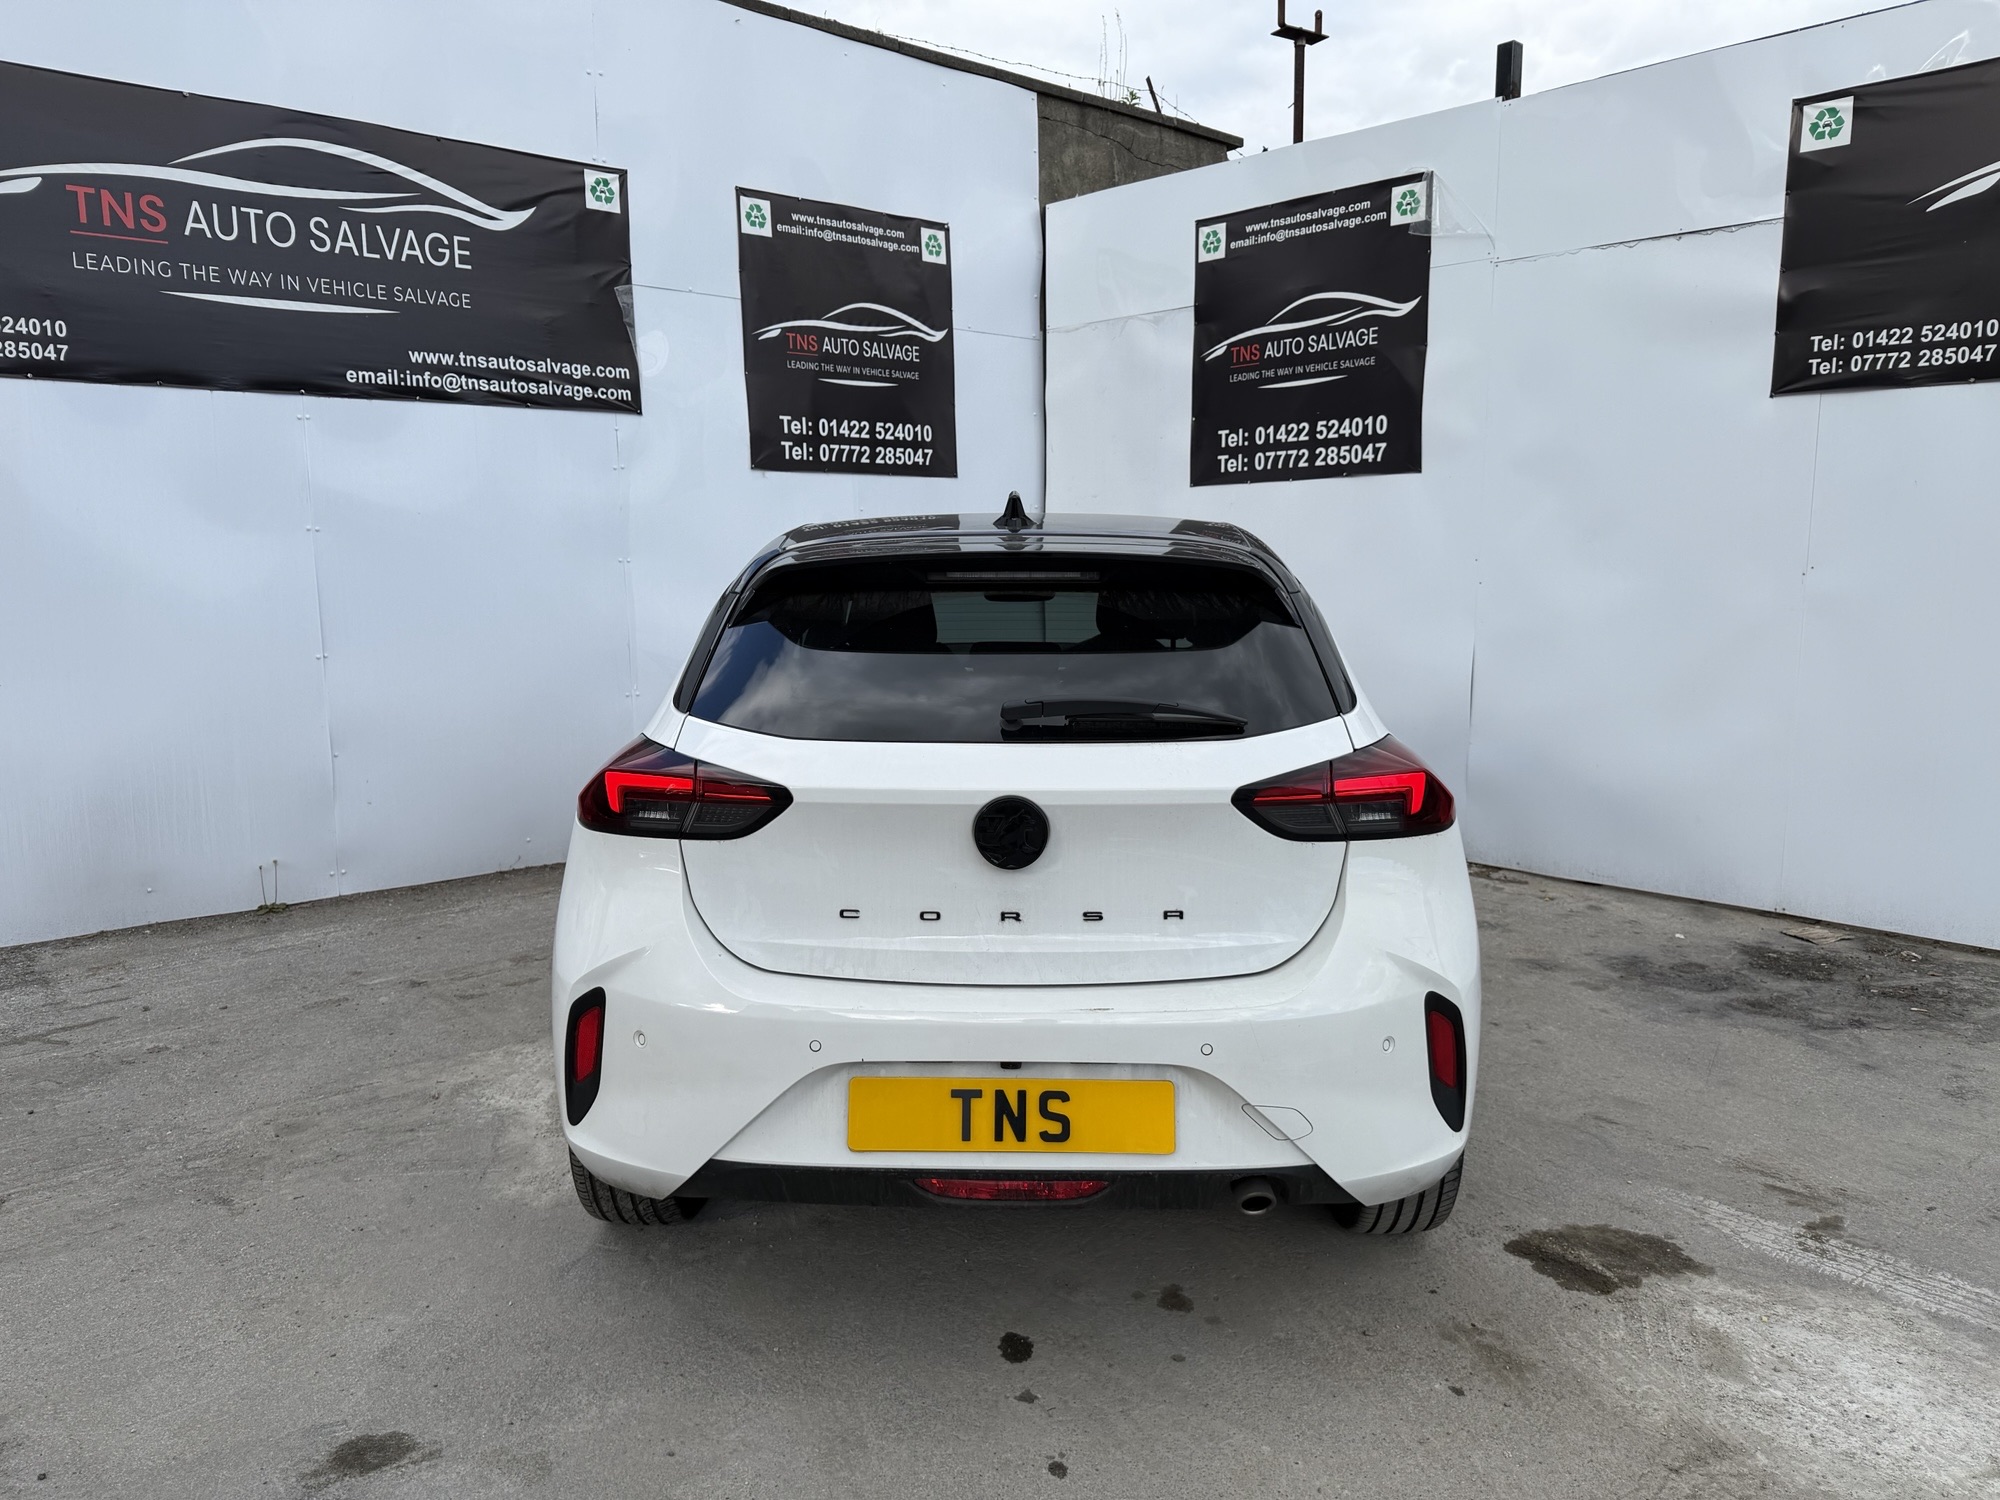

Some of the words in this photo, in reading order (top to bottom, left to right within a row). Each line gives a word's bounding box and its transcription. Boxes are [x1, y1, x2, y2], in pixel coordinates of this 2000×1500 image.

[65, 184, 168, 233] TNS
[184, 200, 296, 248] AUTO
[309, 216, 472, 270] SALVAGE
[791, 213, 905, 239] www.tnsautosalvage.com
[1229, 210, 1387, 250] email:info@tnsautosalvage.com
[1245, 200, 1371, 234] www.tnsautosalvage.com
[776, 222, 920, 254] email:info@tnsautosalvage.com
[71, 251, 172, 279] LEADING
[178, 262, 221, 284] THE
[227, 268, 274, 290] WAY
[280, 274, 300, 292] IN
[306, 276, 387, 300] VEHICLE
[393, 287, 472, 309] SALVAGE
[0, 315, 67, 337] 24010
[1810, 334, 1845, 352] Tel:
[1852, 326, 1913, 349] 01422
[1920, 318, 1999, 343] 524010
[0, 340, 69, 361] 85047
[786, 332, 818, 352] TNS
[822, 336, 860, 357] AUTO
[862, 341, 920, 362] SALVAGE
[1230, 343, 1260, 364] TNS
[1264, 337, 1305, 359] AUTO
[1308, 326, 1379, 353] SALVAGE
[1808, 357, 1843, 376] Tel:
[1850, 350, 1911, 372] 07772
[1917, 344, 1997, 367] 285047
[408, 350, 631, 380] www.tnsautosalvage.com
[786, 359, 819, 371] LEADING
[820, 363, 835, 373] THE
[835, 364, 851, 374] WAY
[852, 366, 861, 375] IN
[861, 367, 890, 378] VEHICLE
[891, 369, 920, 380] SALVAGE
[1229, 370, 1260, 383] LEADING
[1261, 368, 1276, 379] THE
[1276, 366, 1294, 377] WAY
[1294, 365, 1304, 375] IN
[1304, 360, 1338, 374] VEHICLE
[1339, 356, 1376, 370] SALVAGE
[346, 369, 632, 401] email:info@tnsautosalvage.com
[779, 415, 813, 436] Tel:
[818, 418, 870, 439] 01422
[875, 421, 933, 442] 524010
[1218, 427, 1249, 448] Tel:
[1254, 422, 1309, 445] 01422
[1315, 414, 1388, 440] 524010
[780, 441, 814, 461] Tel:
[819, 443, 870, 464] 07772
[875, 446, 933, 466] 285047
[1217, 453, 1248, 473] Tel:
[1254, 448, 1309, 471] 07772
[1315, 442, 1387, 467] 285047
[839, 908, 1185, 922] CORSA
[950, 1089, 1071, 1143] TNS
